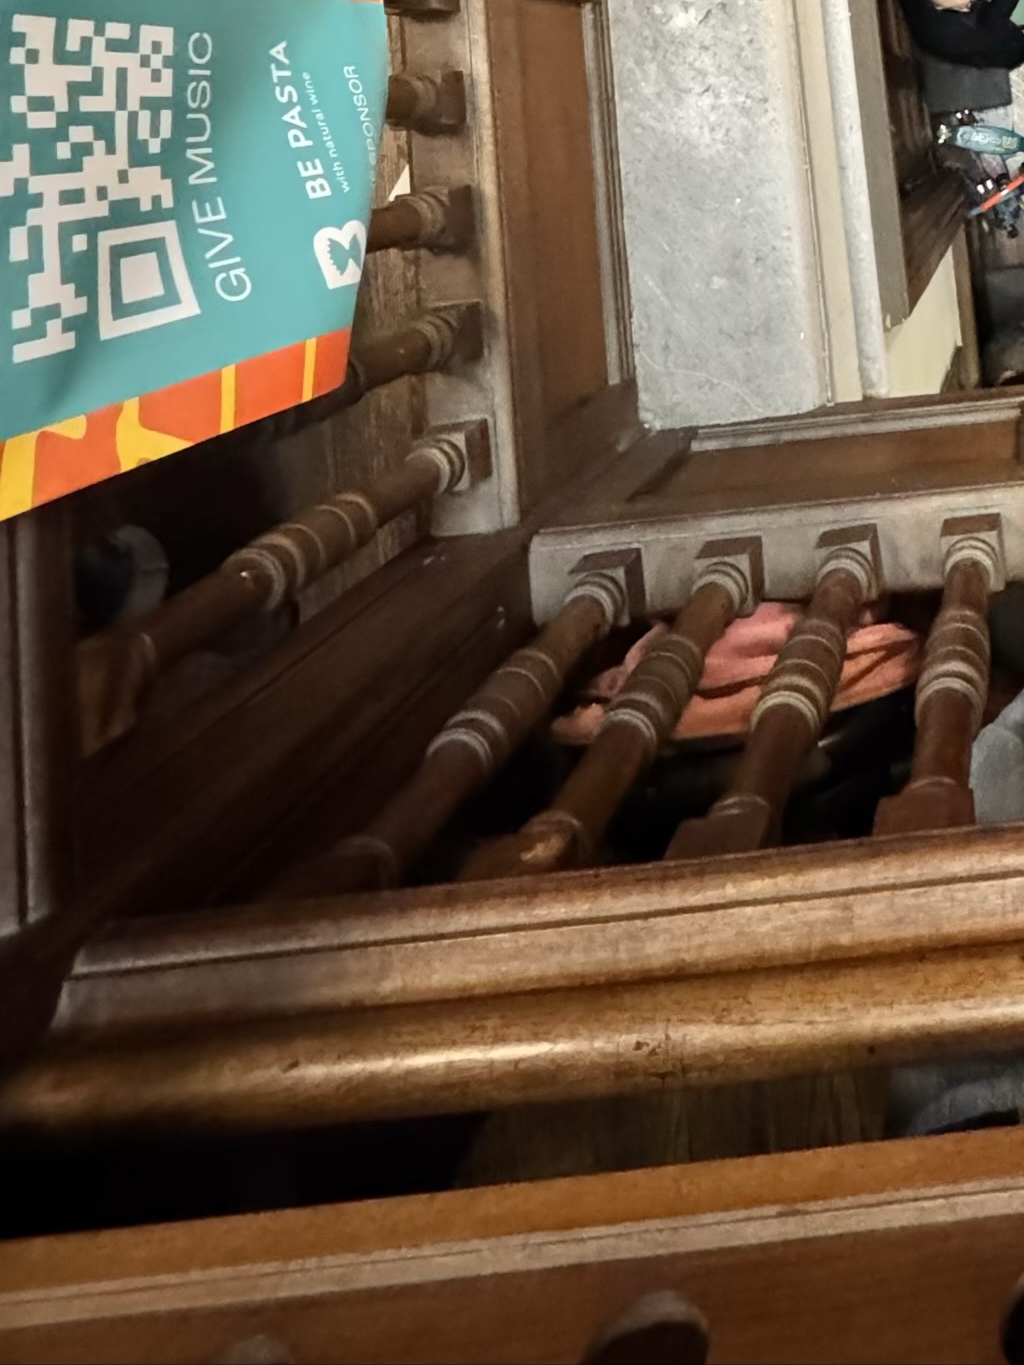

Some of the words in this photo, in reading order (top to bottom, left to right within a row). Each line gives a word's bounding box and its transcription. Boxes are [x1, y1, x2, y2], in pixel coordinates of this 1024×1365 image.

[186, 32, 218, 185] MUSIC
[269, 41, 314, 148] PASTA
[302, 72, 319, 105] wine
[311, 109, 338, 158] natural
[297, 158, 332, 199] BE
[332, 162, 350, 193] with
[192, 196, 252, 301] GIVE
